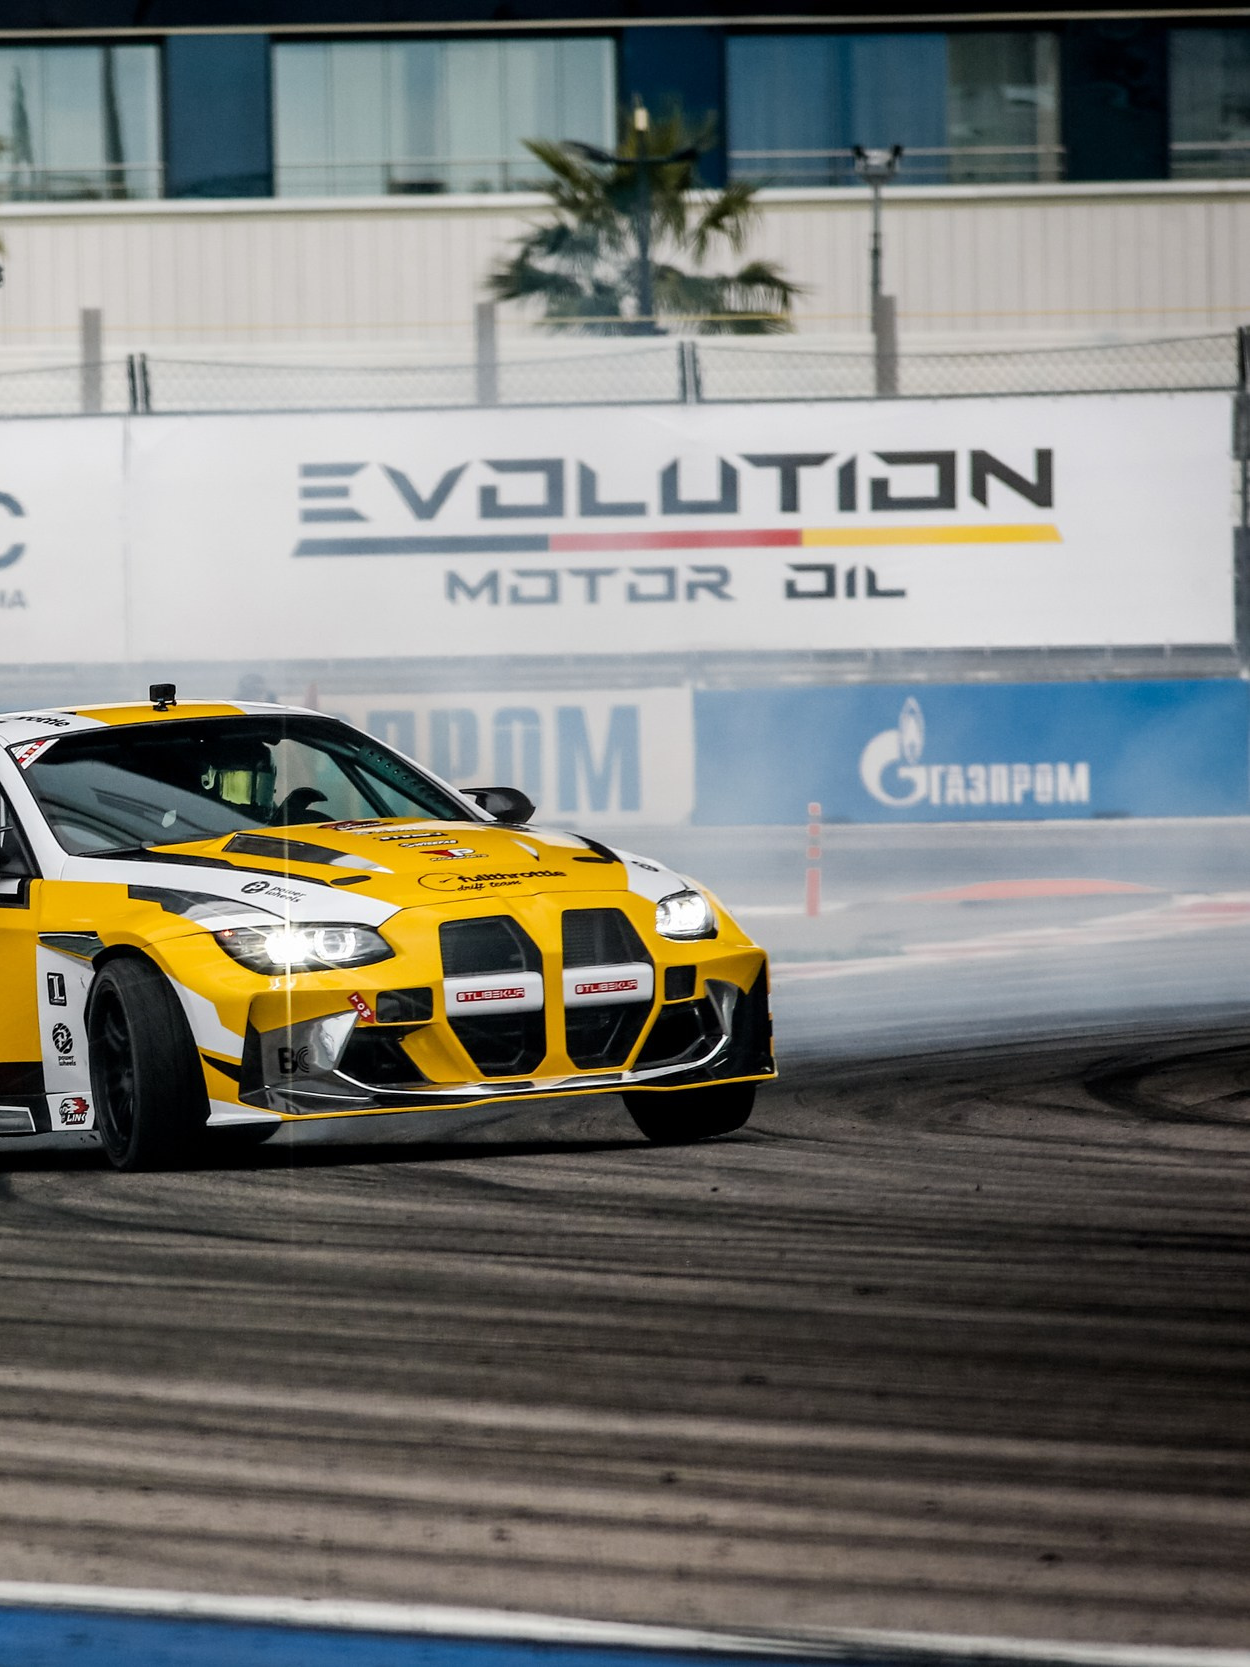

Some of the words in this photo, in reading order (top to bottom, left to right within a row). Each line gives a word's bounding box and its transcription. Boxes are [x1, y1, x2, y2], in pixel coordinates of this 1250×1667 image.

[298, 449, 1054, 523] EVOLUTION
[445, 564, 735, 606] MOTOR
[785, 563, 907, 601] OIL
[928, 762, 1091, 806] ГАЗПРОМ
[350, 993, 371, 1018] TOW
